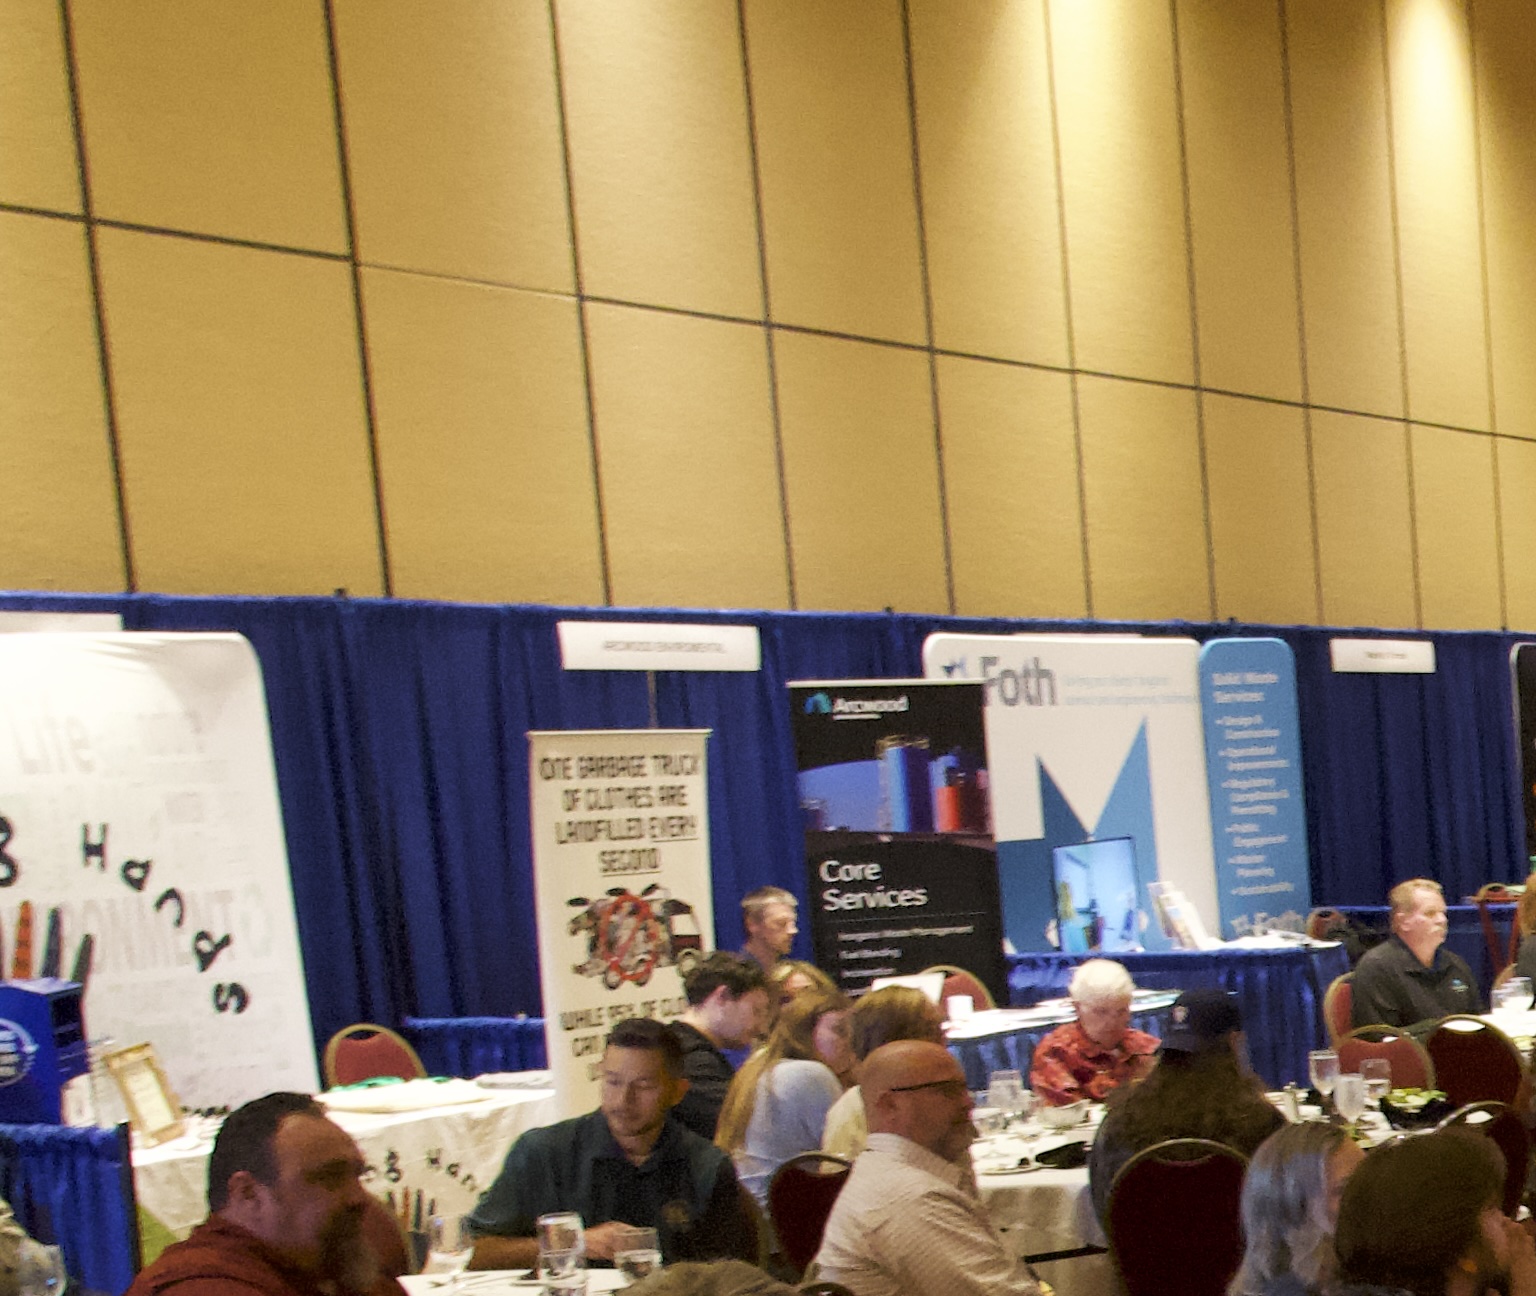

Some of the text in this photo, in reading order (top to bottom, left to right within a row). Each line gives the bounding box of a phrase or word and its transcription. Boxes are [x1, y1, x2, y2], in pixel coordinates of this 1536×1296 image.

[979, 656, 1057, 707] Foth
[834, 696, 909, 713] Arcwood
[540, 753, 699, 780] ONE GARBAGE TRUCK
[562, 784, 688, 811] OF CLOTHES ARE
[553, 817, 644, 844] LANDFILLED
[599, 848, 661, 872] SECOND
[819, 861, 881, 882] Core
[822, 887, 928, 912] Services
